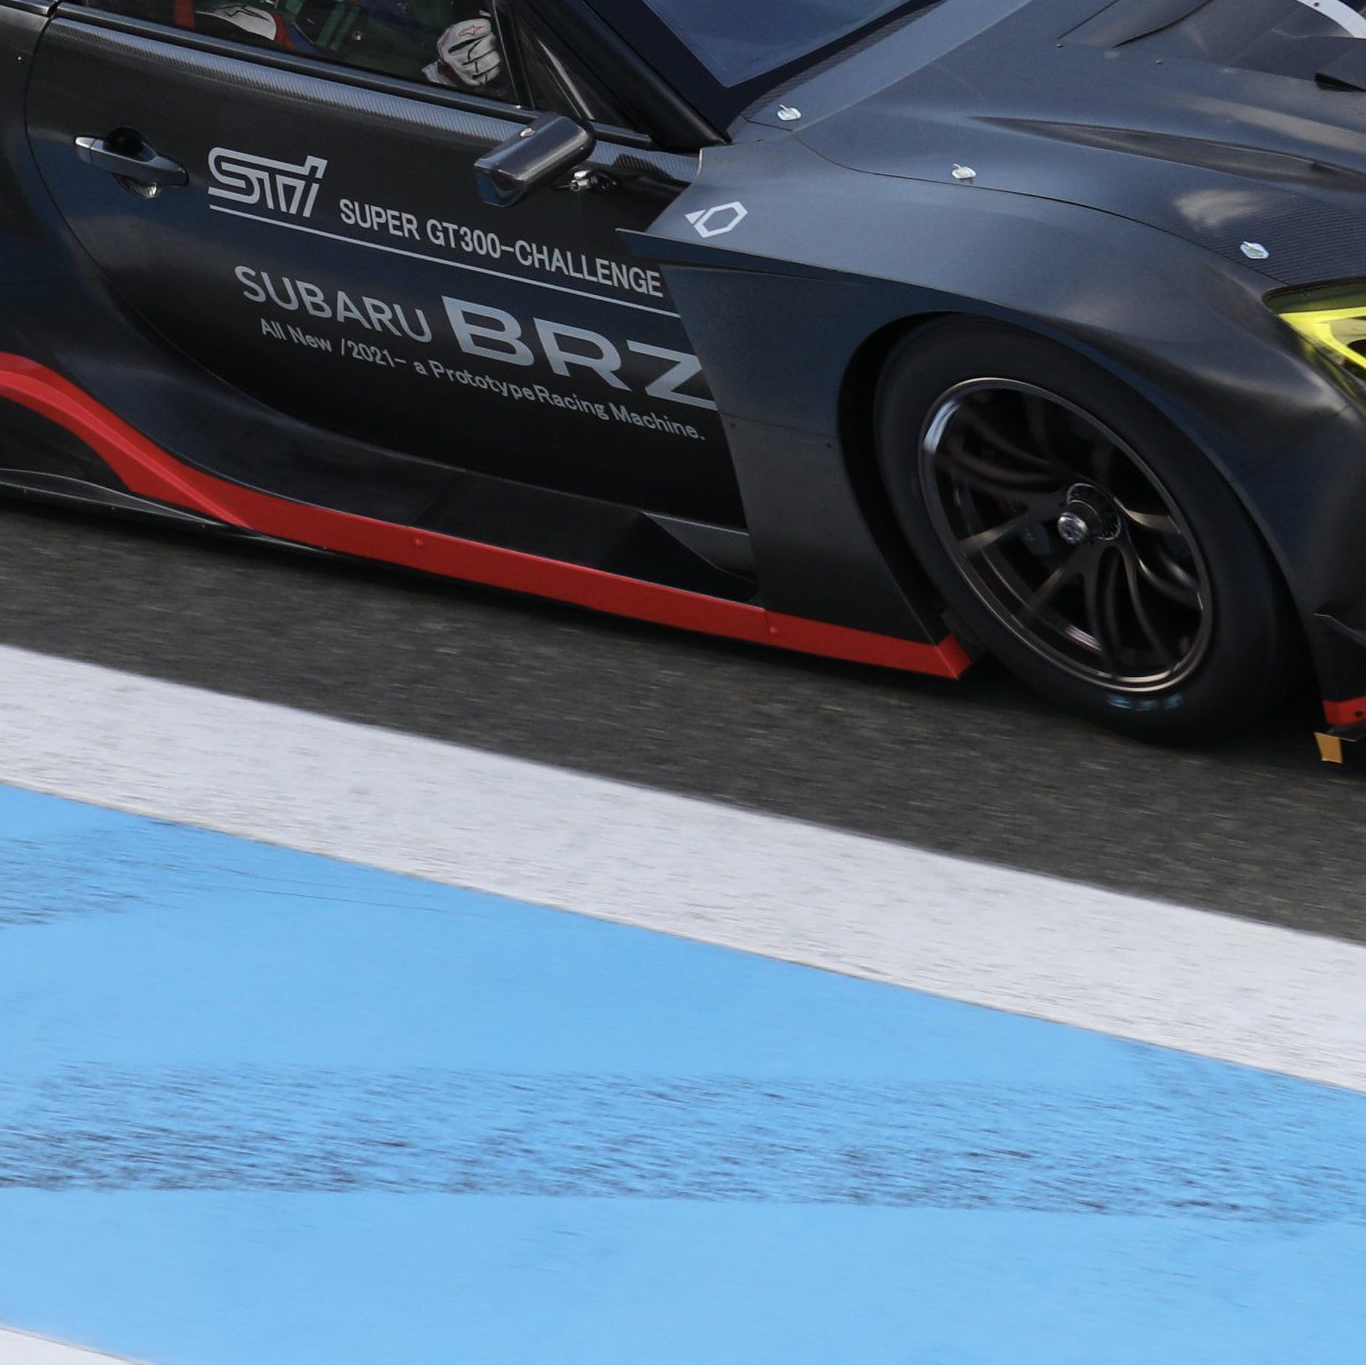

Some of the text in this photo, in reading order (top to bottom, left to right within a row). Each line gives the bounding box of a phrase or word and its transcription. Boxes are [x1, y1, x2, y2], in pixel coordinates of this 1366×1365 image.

[339, 198, 664, 298] SUPER GT300-CHALLENGE
[234, 265, 718, 411] SUBARU BRZ
[260, 318, 286, 340] All
[287, 324, 332, 353] New
[413, 361, 428, 376] a
[609, 403, 706, 441] Machine.
